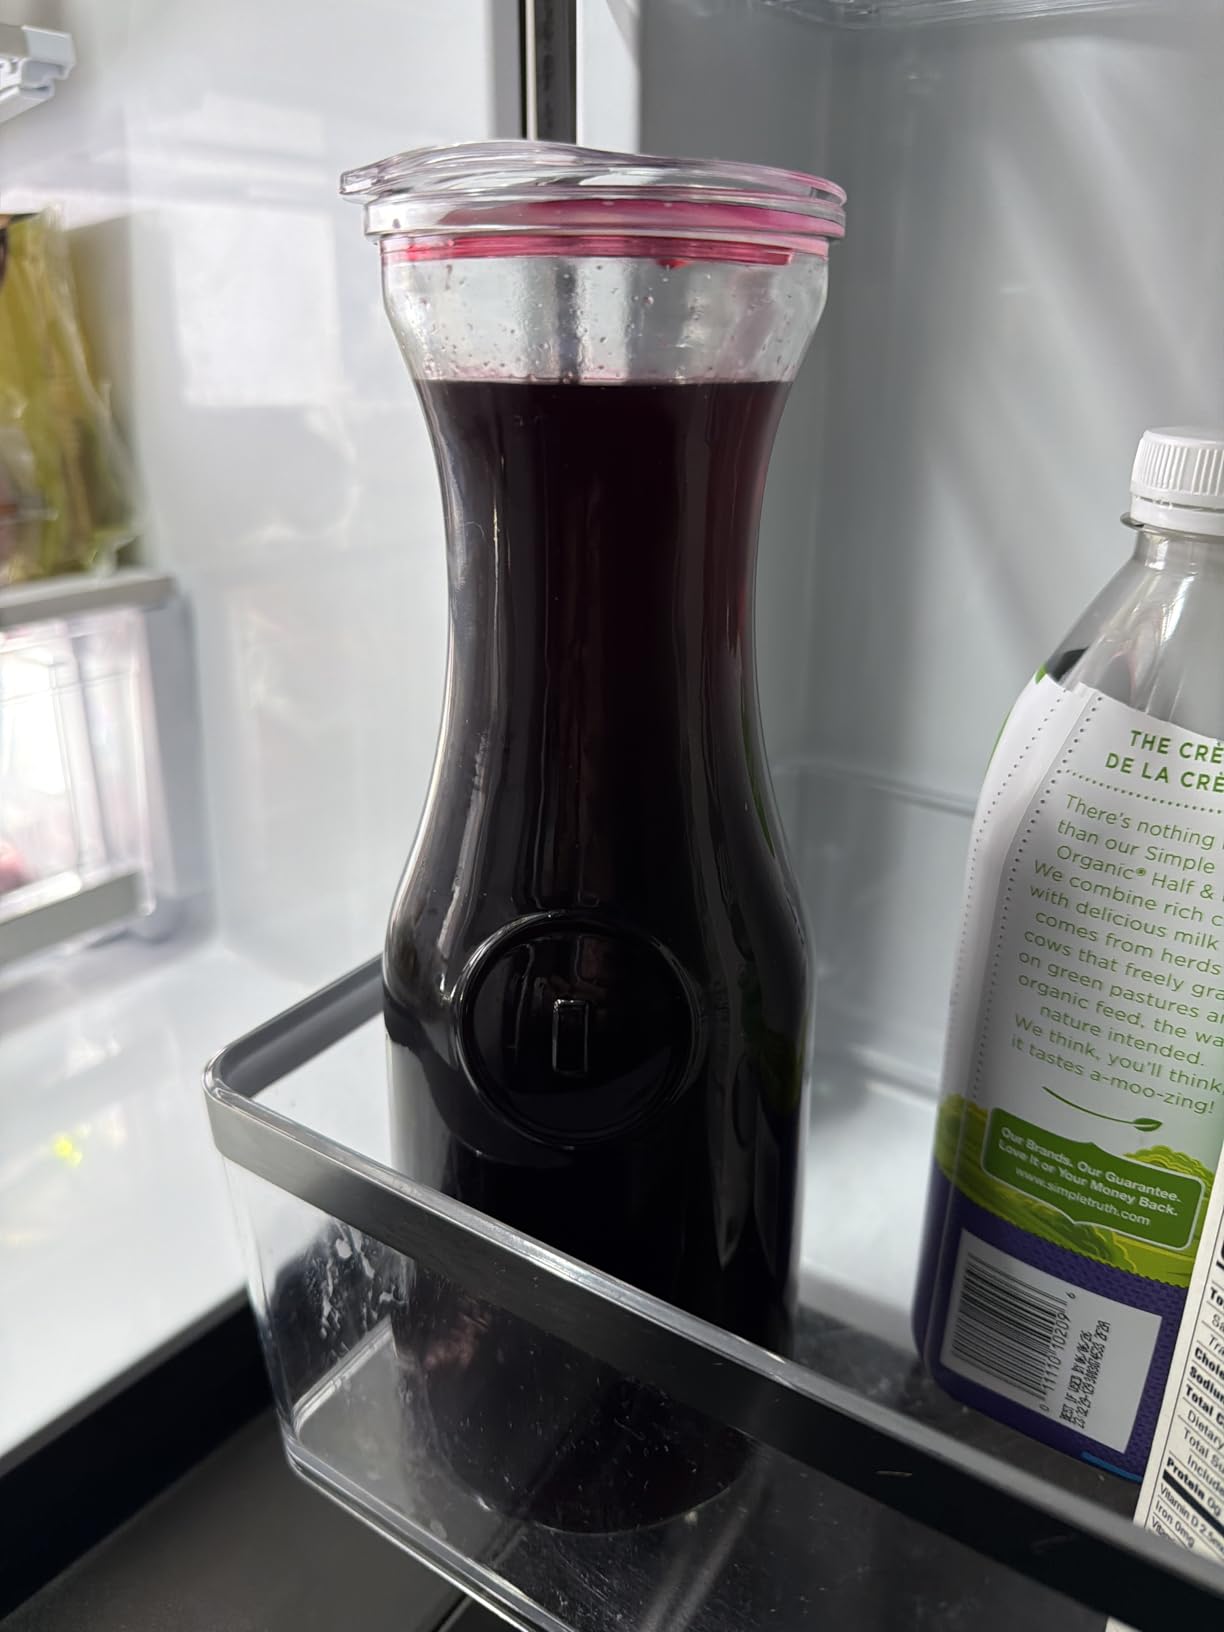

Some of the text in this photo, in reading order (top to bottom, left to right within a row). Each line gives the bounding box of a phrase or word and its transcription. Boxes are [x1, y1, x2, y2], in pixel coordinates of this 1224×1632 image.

[1105, 752, 1134, 774] DE
[1142, 762, 1168, 783] LA
[1131, 730, 1171, 754] THE
[1057, 819, 1215, 874] than our Simple
[1067, 794, 1215, 850] There's nothing
[1034, 859, 1062, 882] We
[1070, 875, 1157, 910] combine
[1164, 902, 1203, 922] rich
[1152, 872, 1195, 895] Half
[1200, 884, 1214, 900] &
[1030, 885, 1218, 951] with delicious milk
[1036, 912, 1221, 976] comes from herds
[1018, 951, 1041, 969] on
[1047, 963, 1103, 990] green
[1109, 984, 1199, 1018] pastures
[1024, 930, 1072, 956] cows
[1079, 949, 1118, 972] that
[1125, 963, 1184, 991] freely
[1018, 975, 1089, 1009] organic
[1153, 1018, 1187, 1039] the
[1040, 1005, 1204, 1066] nature intended.
[1011, 1034, 1215, 1114] it tastes a-moo-zing!
[1015, 1013, 1042, 1036] We
[1107, 1053, 1162, 1077] you'll
[999, 1139, 1028, 1160] Love
[1041, 1162, 1057, 1174] or
[1058, 1166, 1087, 1186] Your
[1090, 1179, 1136, 1206] Money
[1138, 1195, 1178, 1217] Back.
[1001, 1127, 1024, 1144] Our
[1077, 1161, 1102, 1177] Our
[1105, 1171, 1182, 1202] Guarantee.
[1016, 1167, 1150, 1226] www.simpletruth.com
[1040, 1292, 1076, 1412] 0 11110 10209 6
[1186, 1384, 1214, 1416] Total
[1188, 1409, 1224, 1450] Dietary
[1184, 1426, 1210, 1458] Total
[1160, 1482, 1190, 1520] Vitamin
[1191, 1515, 1200, 1528] D
[1166, 1457, 1205, 1500] Protein
[1155, 1500, 1173, 1525] Iron
[1175, 1521, 1195, 1548] 0mg
